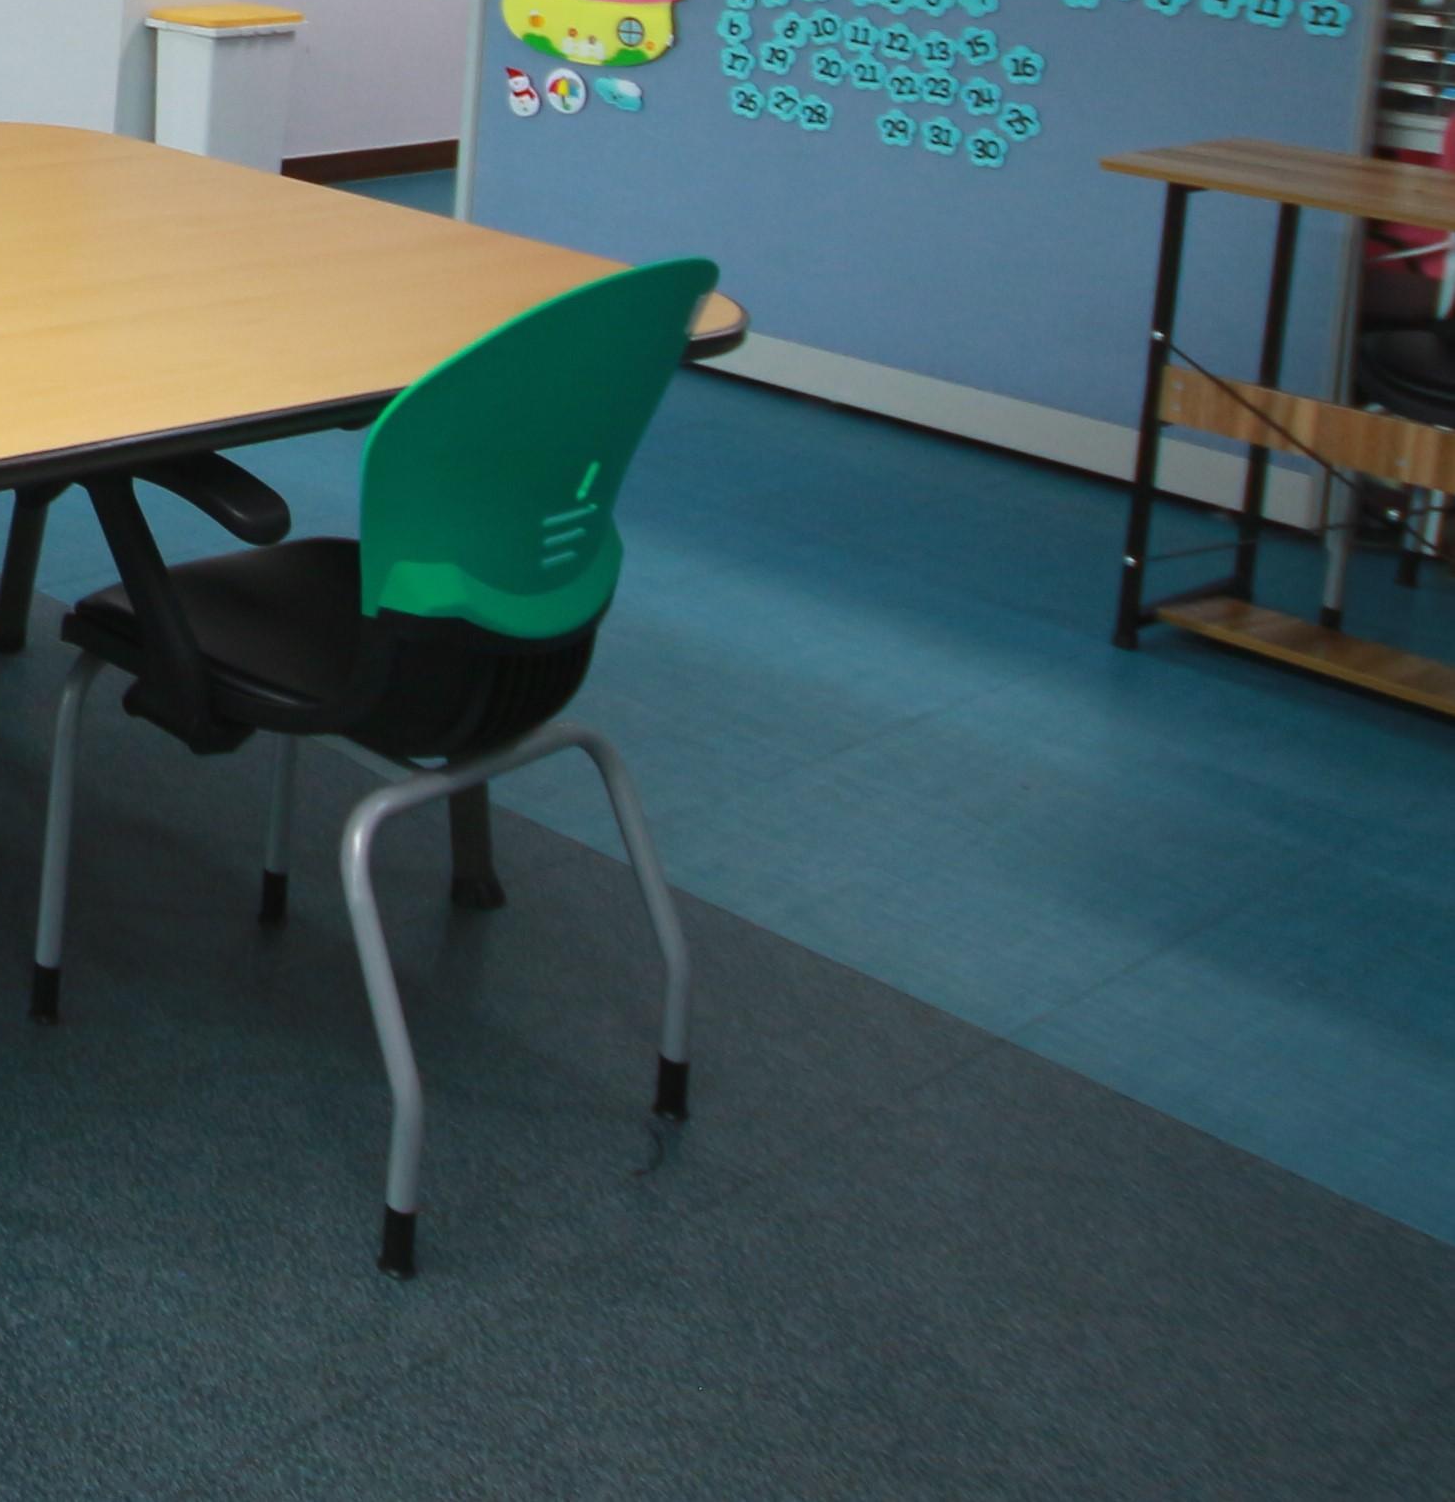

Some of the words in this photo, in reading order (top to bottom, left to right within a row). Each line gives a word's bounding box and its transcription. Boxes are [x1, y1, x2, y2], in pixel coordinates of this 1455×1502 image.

[783, 20, 800, 39] 8
[811, 16, 838, 38] 10
[849, 25, 871, 46] 11
[885, 31, 910, 53] 12
[925, 40, 951, 62] 13
[965, 34, 990, 58] 15
[1010, 57, 1038, 78] 16
[1308, 4, 1342, 28] 12
[727, 52, 750, 72] 17
[765, 46, 788, 68] 19
[816, 56, 842, 79] 20
[854, 62, 880, 84] 21
[890, 75, 918, 96] 22
[924, 76, 951, 99] 23
[1005, 107, 1035, 136] 25
[773, 90, 799, 114] 27
[801, 103, 829, 125] 28
[881, 118, 909, 139] 29
[928, 124, 953, 148] 31
[972, 137, 1001, 160] 30
